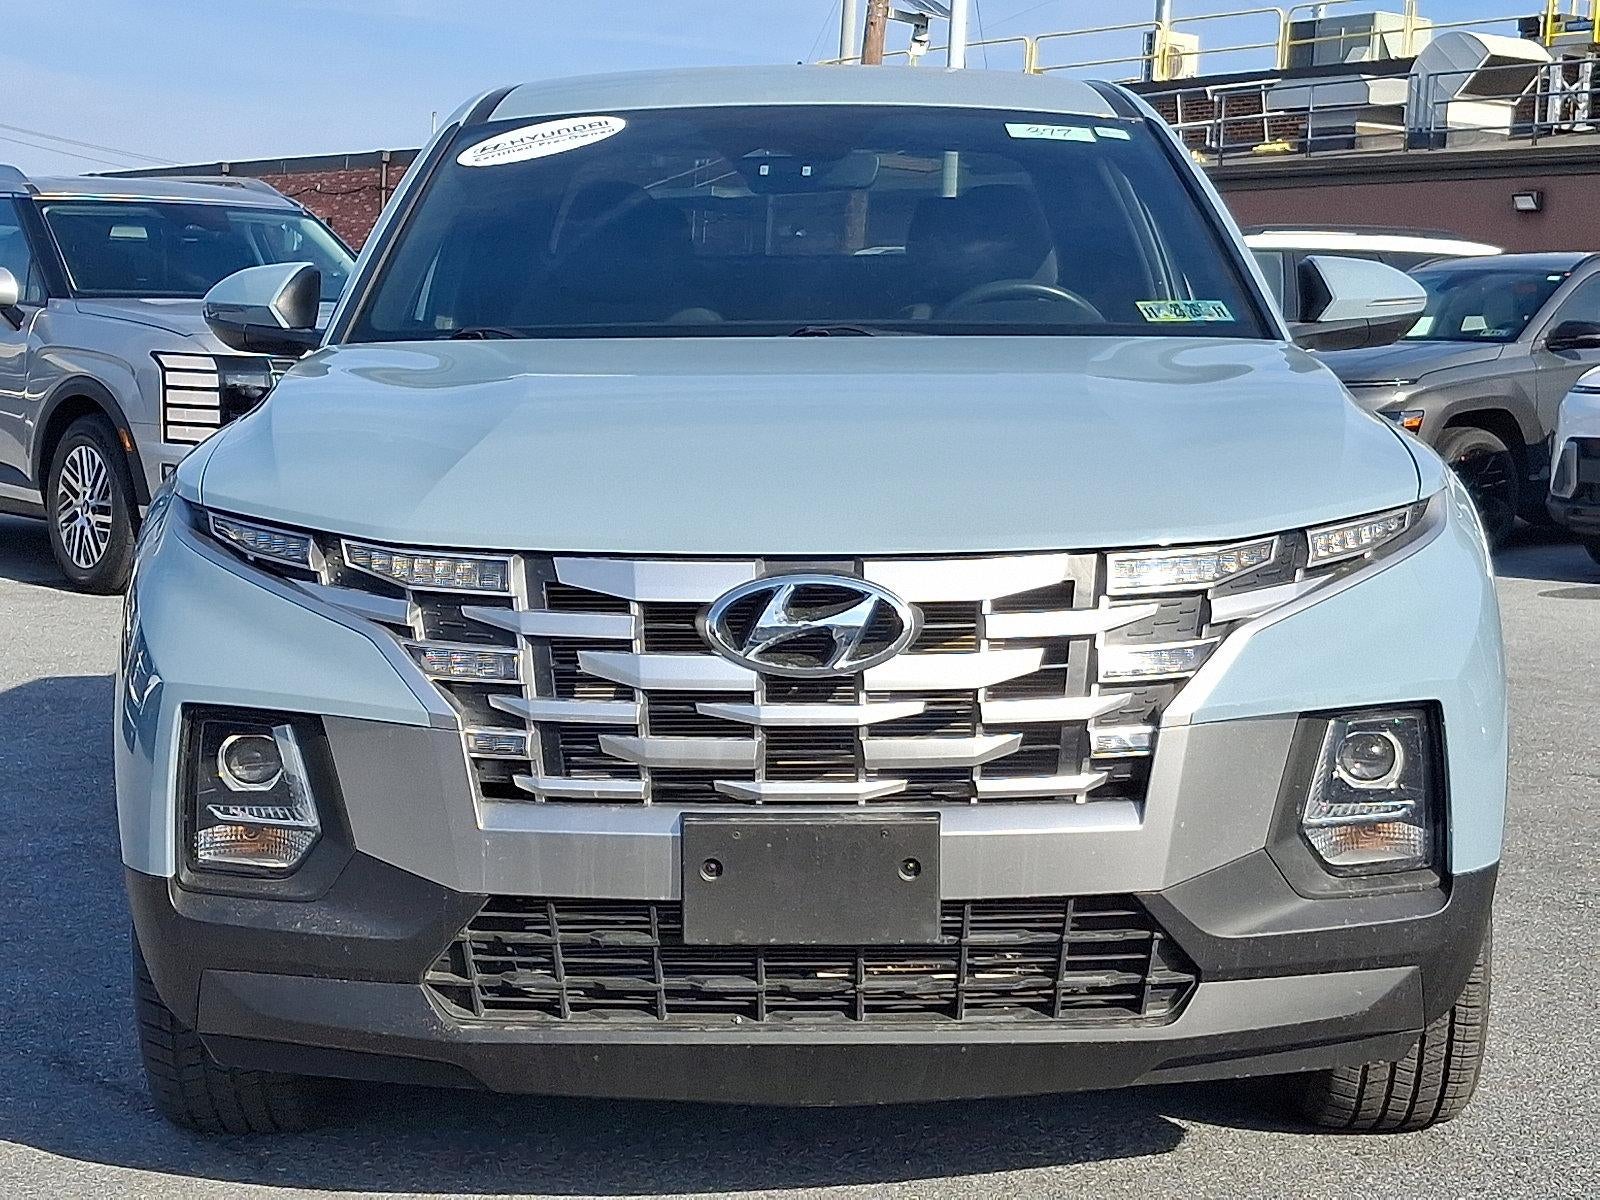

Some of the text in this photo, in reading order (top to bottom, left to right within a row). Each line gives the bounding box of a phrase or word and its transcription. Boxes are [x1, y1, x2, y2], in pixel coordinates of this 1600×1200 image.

[474, 128, 616, 162] Certified Pre-Owned
[510, 120, 610, 146] HYUNDAI
